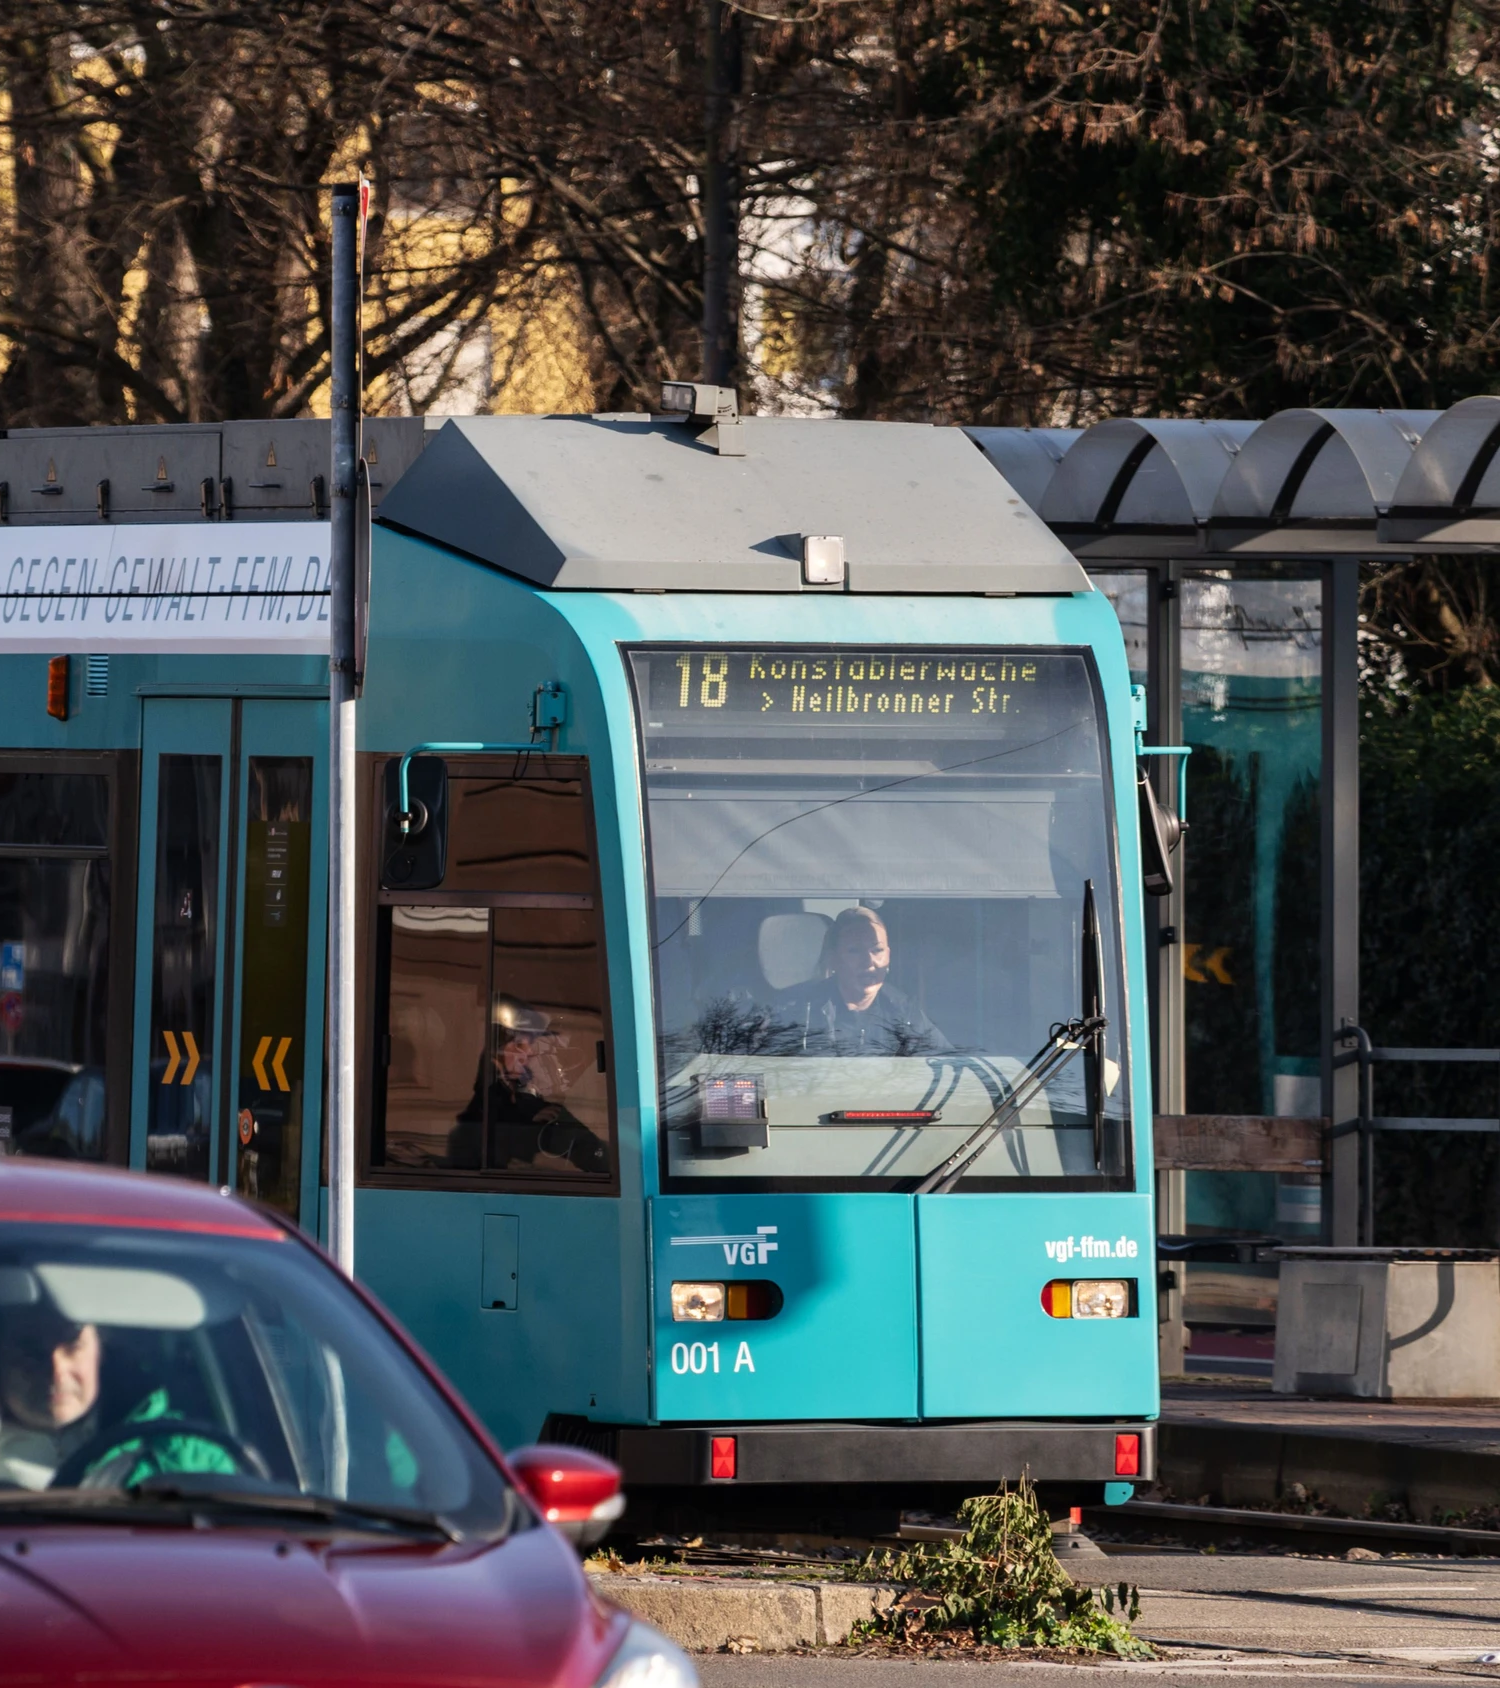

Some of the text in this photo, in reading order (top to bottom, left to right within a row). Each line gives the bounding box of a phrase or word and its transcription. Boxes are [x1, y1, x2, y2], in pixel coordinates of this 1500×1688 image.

[676, 653, 728, 708] 18
[749, 654, 1037, 682] Konstablerwache
[791, 685, 1020, 714] Heilbronner Str.
[723, 1226, 778, 1265] VGF
[1044, 1235, 1138, 1263] vgf-ffm.de
[671, 1341, 756, 1375] 001 A
